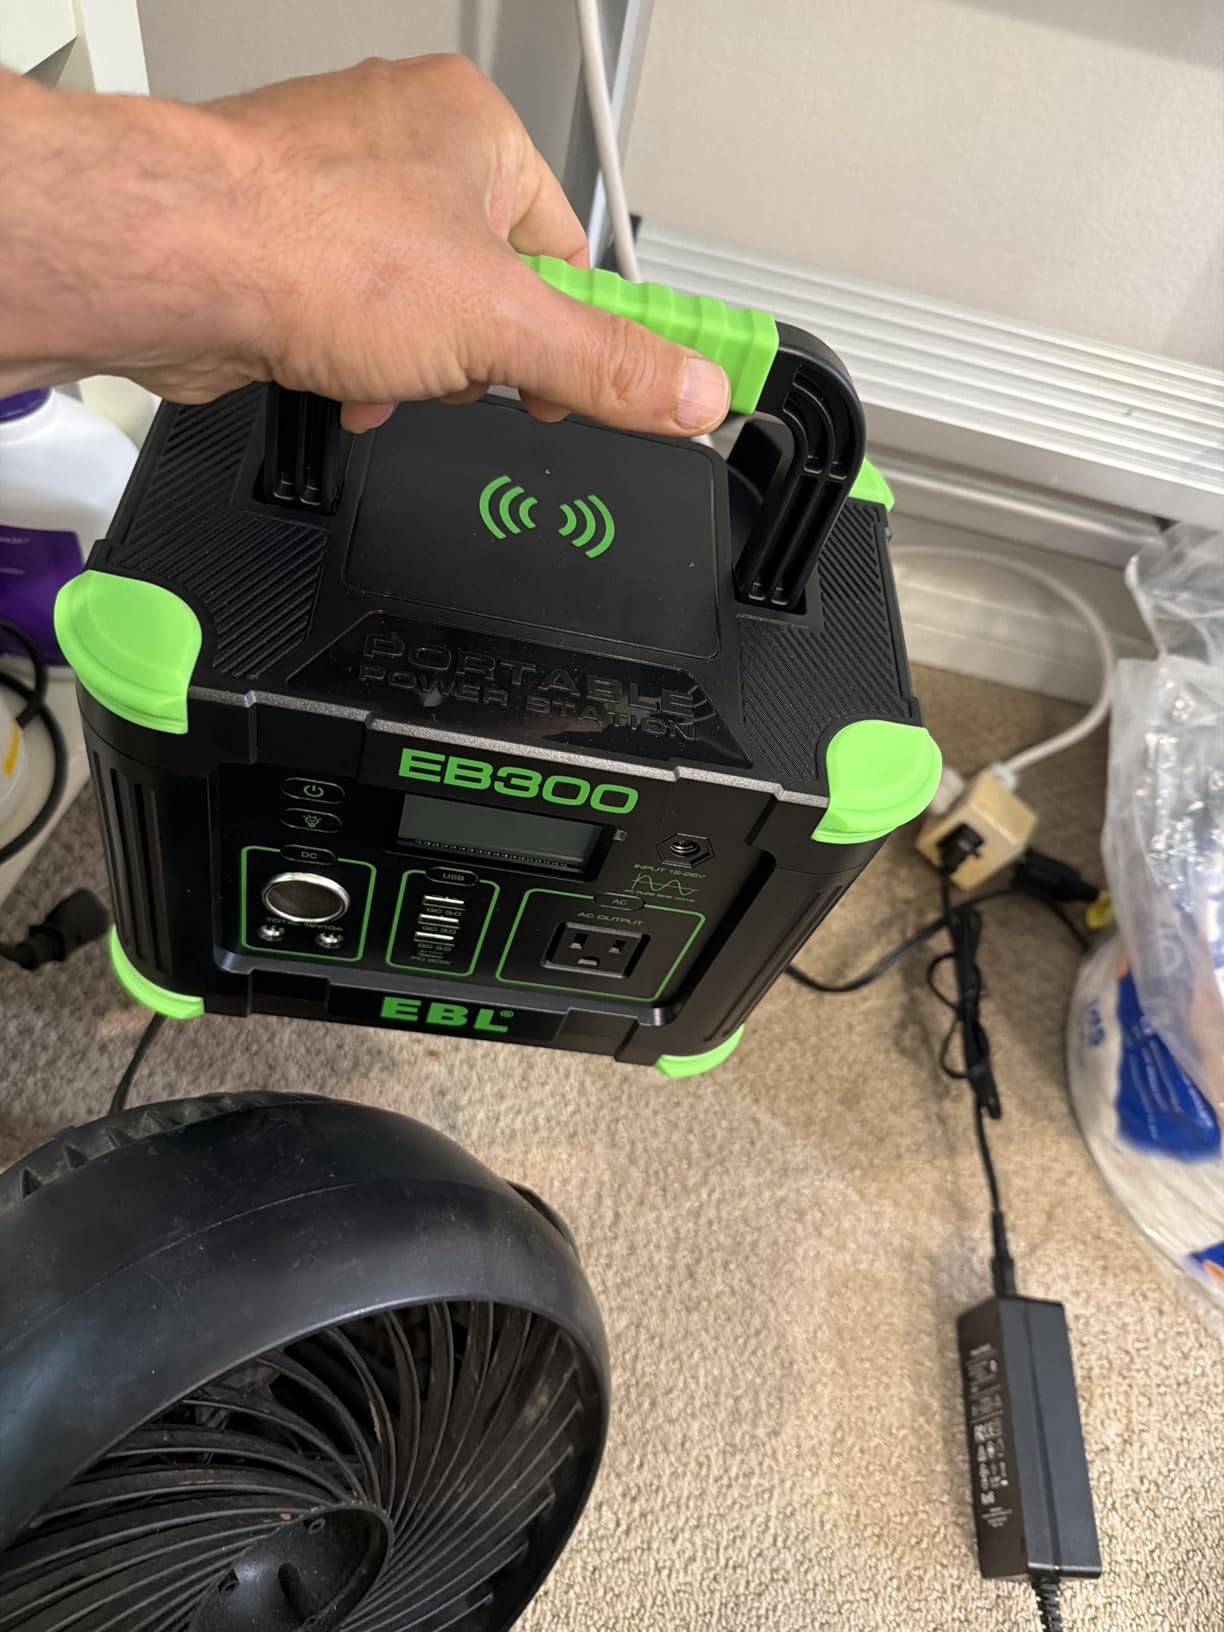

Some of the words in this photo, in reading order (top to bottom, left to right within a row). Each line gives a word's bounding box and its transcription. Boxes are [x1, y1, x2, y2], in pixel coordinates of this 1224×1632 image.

[363, 632, 696, 718] PORTABLE
[359, 663, 510, 707] POWER
[526, 694, 697, 741] STATION
[399, 748, 639, 814] EB300
[301, 851, 318, 860] DC
[633, 863, 667, 873] INPUT
[442, 872, 465, 881] USB
[611, 898, 628, 906] AC
[577, 911, 594, 919] AC
[597, 914, 645, 926] OUTPUT
